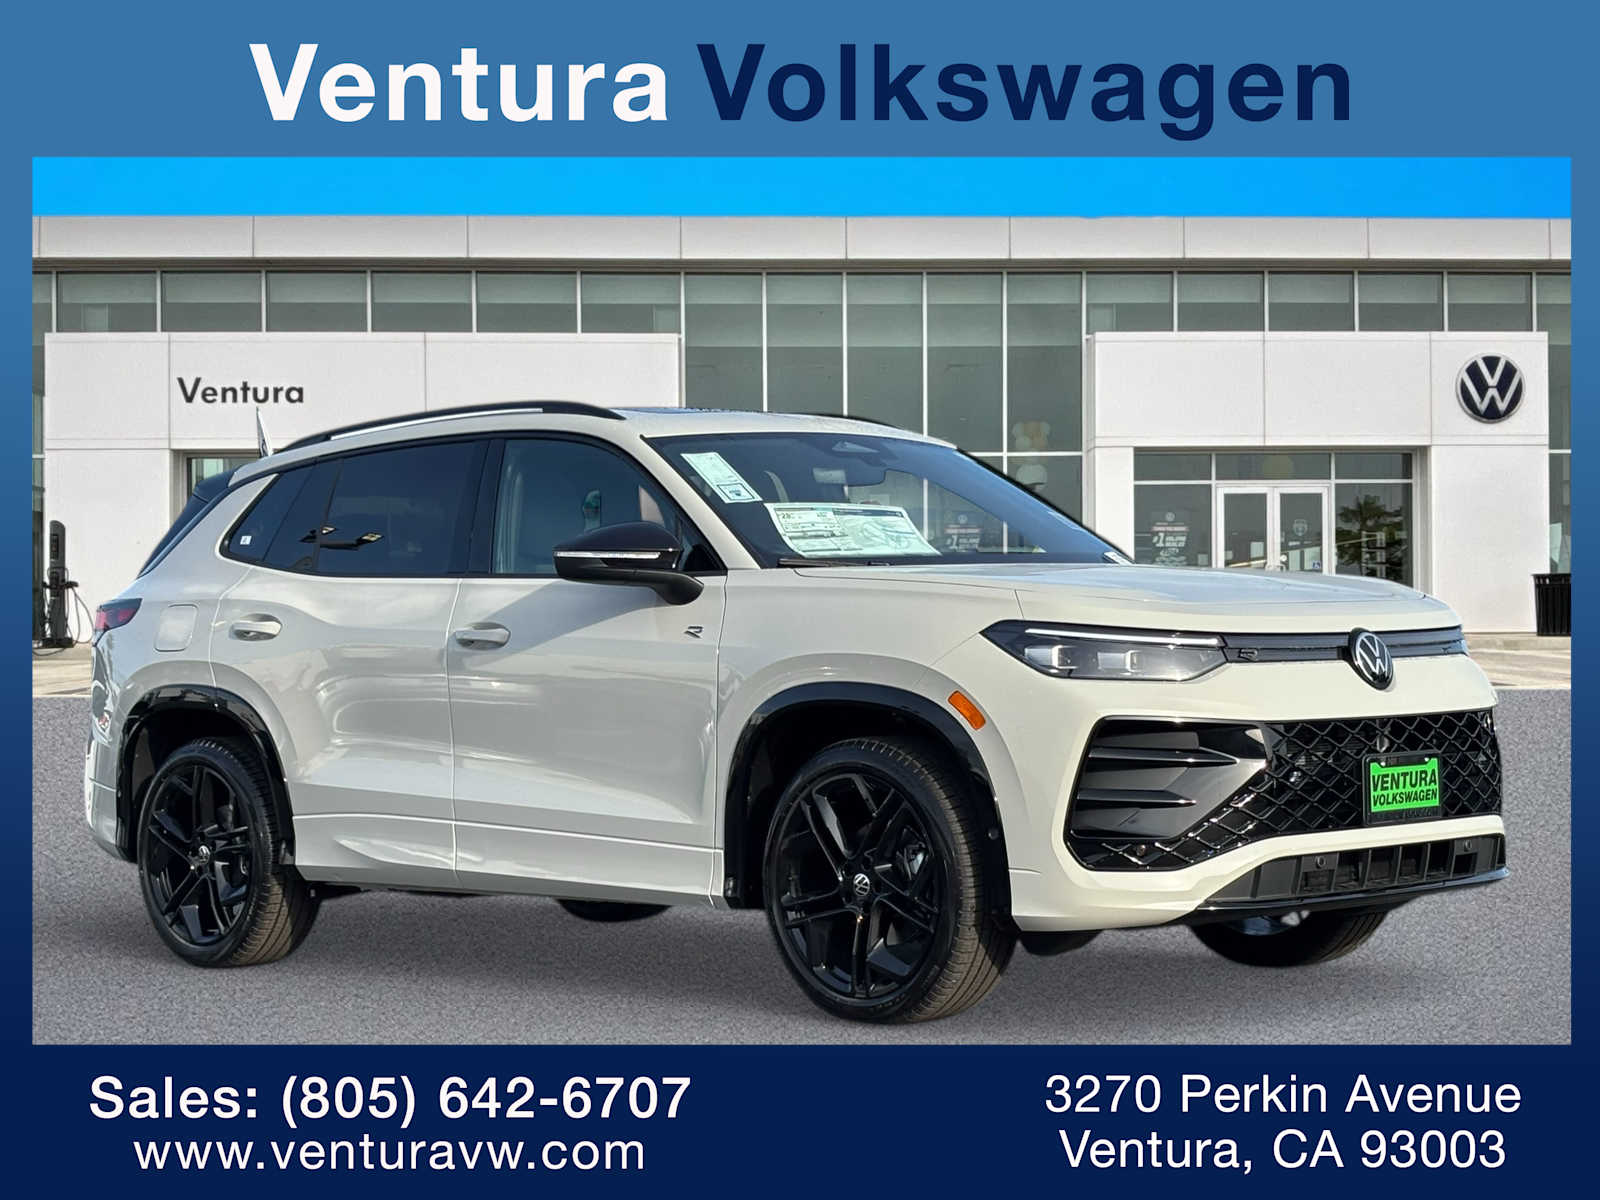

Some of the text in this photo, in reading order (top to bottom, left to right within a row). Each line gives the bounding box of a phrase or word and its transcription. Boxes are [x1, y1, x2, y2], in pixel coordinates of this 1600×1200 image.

[177, 377, 304, 403] Ventura
[1371, 769, 1437, 792] VENTURA
[1372, 788, 1438, 807] VOLKSWAGEN
